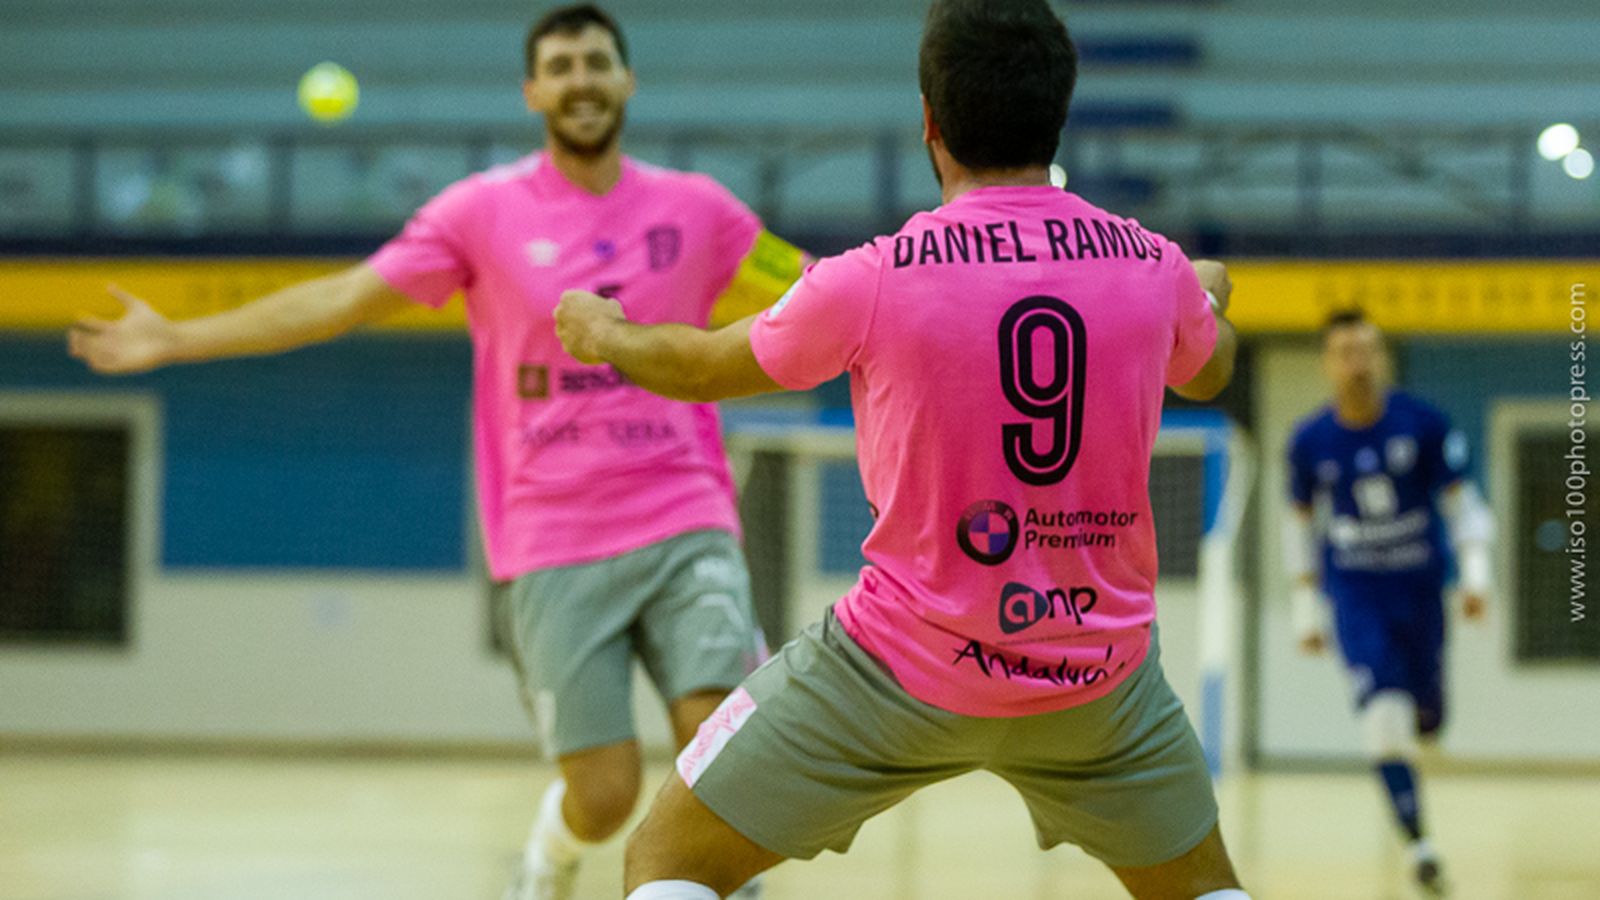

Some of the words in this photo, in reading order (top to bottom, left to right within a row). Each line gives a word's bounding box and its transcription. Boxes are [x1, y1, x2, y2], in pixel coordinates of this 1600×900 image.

[894, 220, 1037, 269] DANIEL
[1043, 218, 1162, 263] RAMOS
[998, 295, 1088, 487] 9
[1024, 508, 1139, 528] Automotor
[1025, 528, 1116, 550] Premium
[1002, 585, 1098, 626] anp
[952, 639, 1126, 686] Andalucí
